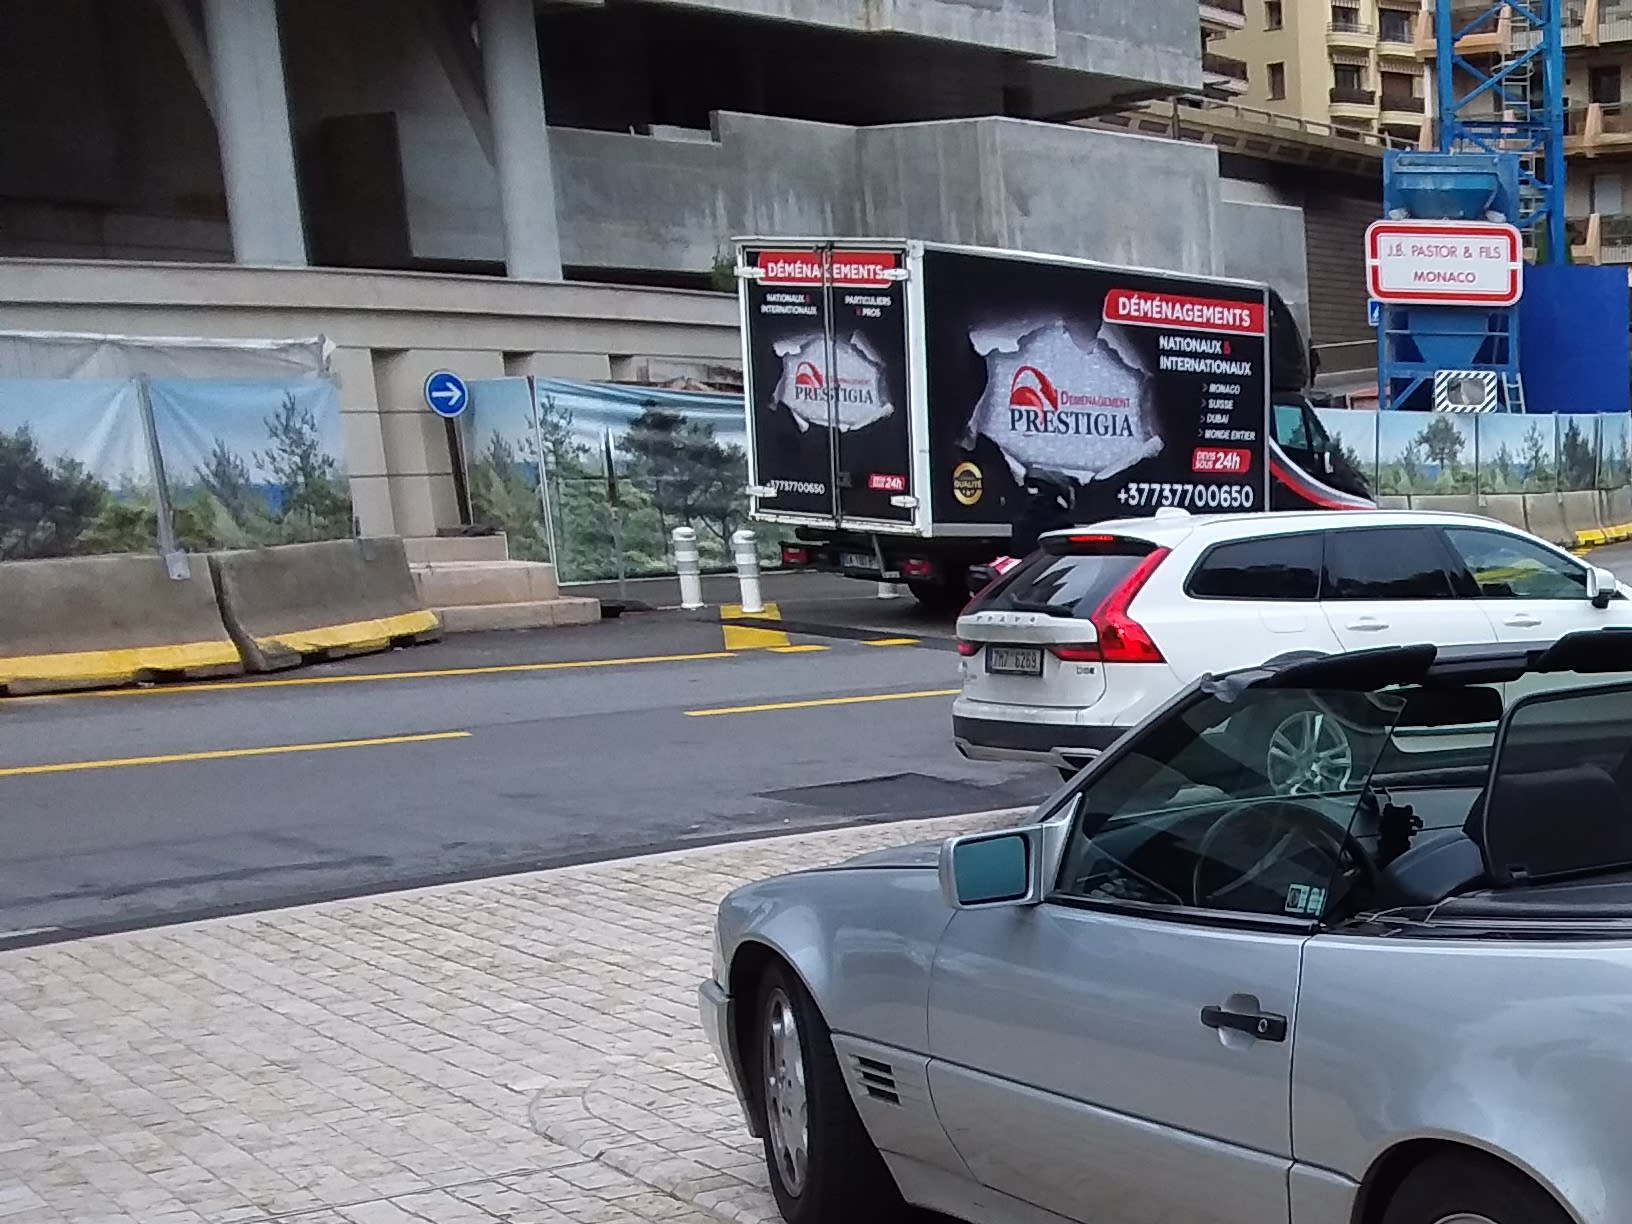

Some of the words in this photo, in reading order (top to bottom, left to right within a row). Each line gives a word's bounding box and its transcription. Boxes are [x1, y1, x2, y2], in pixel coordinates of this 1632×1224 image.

[1411, 244, 1457, 258] PASTOR
[1463, 246, 1473, 258] &
[1480, 246, 1502, 259] FILS
[767, 260, 883, 279] DÉMÉNAEMENTS
[1413, 271, 1476, 283] MONACO
[1118, 294, 1251, 327] DÉMÉNAGEMENTS
[1160, 335, 1222, 355] NATIONAUX
[1160, 356, 1252, 375] INTERNATIONAUX
[1209, 383, 1241, 394] MONACO
[1208, 399, 1234, 410] SUISSE
[1009, 407, 1134, 437] PRESTIGIA
[1206, 414, 1229, 425] DUBAI
[1204, 429, 1230, 440] MONDE
[1230, 430, 1256, 441] ENTIER
[1215, 452, 1241, 469] 24h
[1117, 483, 1254, 508] +37737700650
